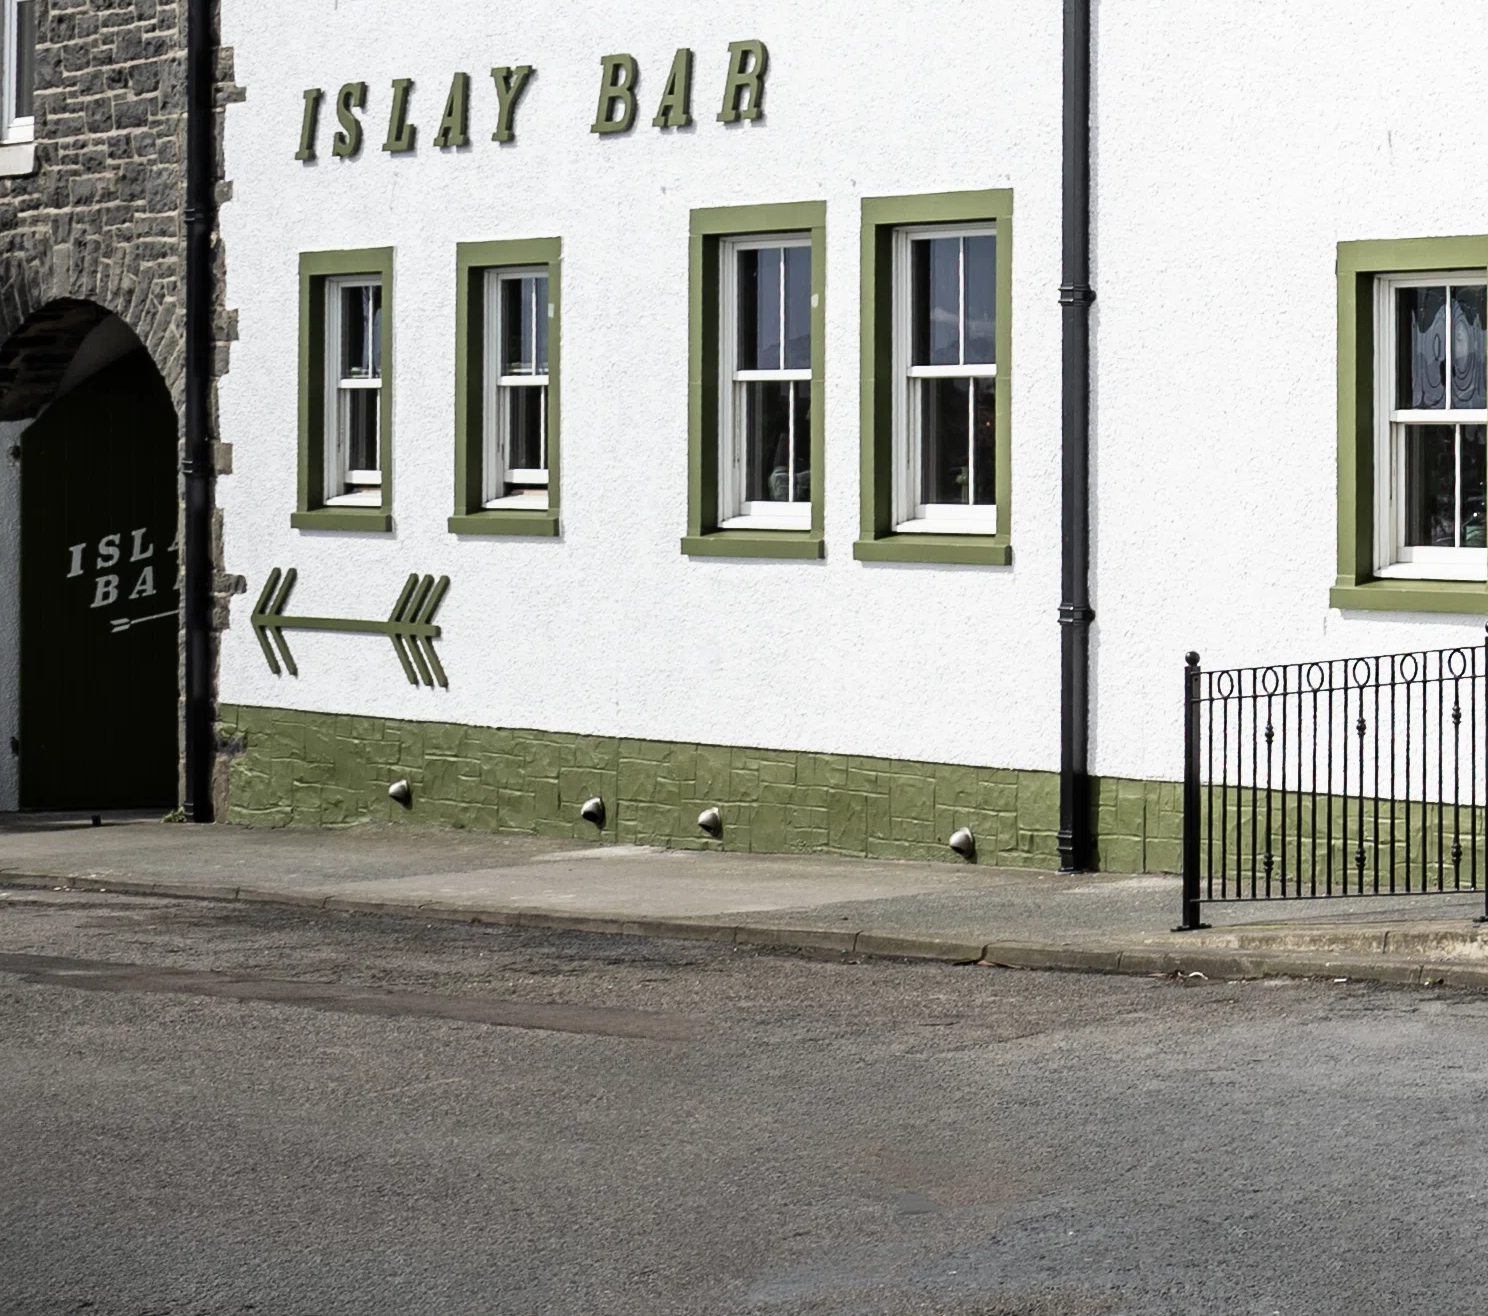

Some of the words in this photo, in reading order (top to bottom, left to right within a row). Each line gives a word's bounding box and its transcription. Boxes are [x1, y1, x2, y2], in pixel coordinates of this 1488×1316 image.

[294, 64, 535, 161] ISLAY
[590, 38, 770, 134] BAR
[89, 565, 181, 609] BA
